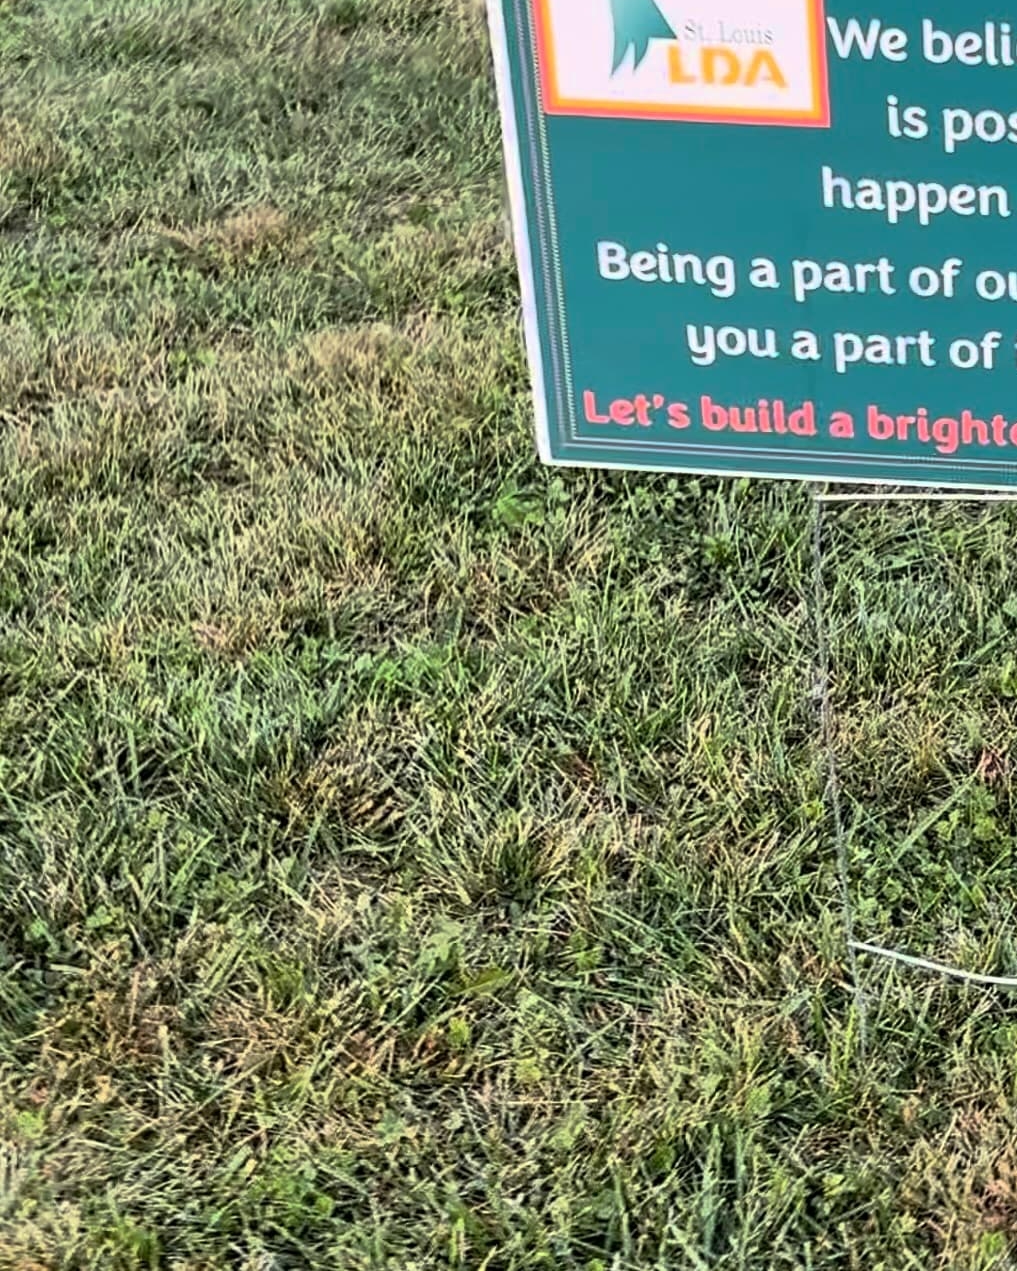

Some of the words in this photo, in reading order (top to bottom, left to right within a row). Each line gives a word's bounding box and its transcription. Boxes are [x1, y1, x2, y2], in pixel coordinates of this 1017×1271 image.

[826, 17, 908, 62] We
[668, 44, 788, 88] LDA
[887, 95, 929, 139] is
[822, 166, 1011, 226] happen
[597, 241, 736, 298] Being
[749, 258, 780, 288] a
[792, 257, 896, 302] part
[909, 258, 962, 298] of
[686, 324, 778, 366] you
[791, 330, 821, 360] a
[833, 330, 935, 373] part
[949, 331, 1002, 369] of
[700, 395, 817, 436] build
[828, 411, 855, 439] a
